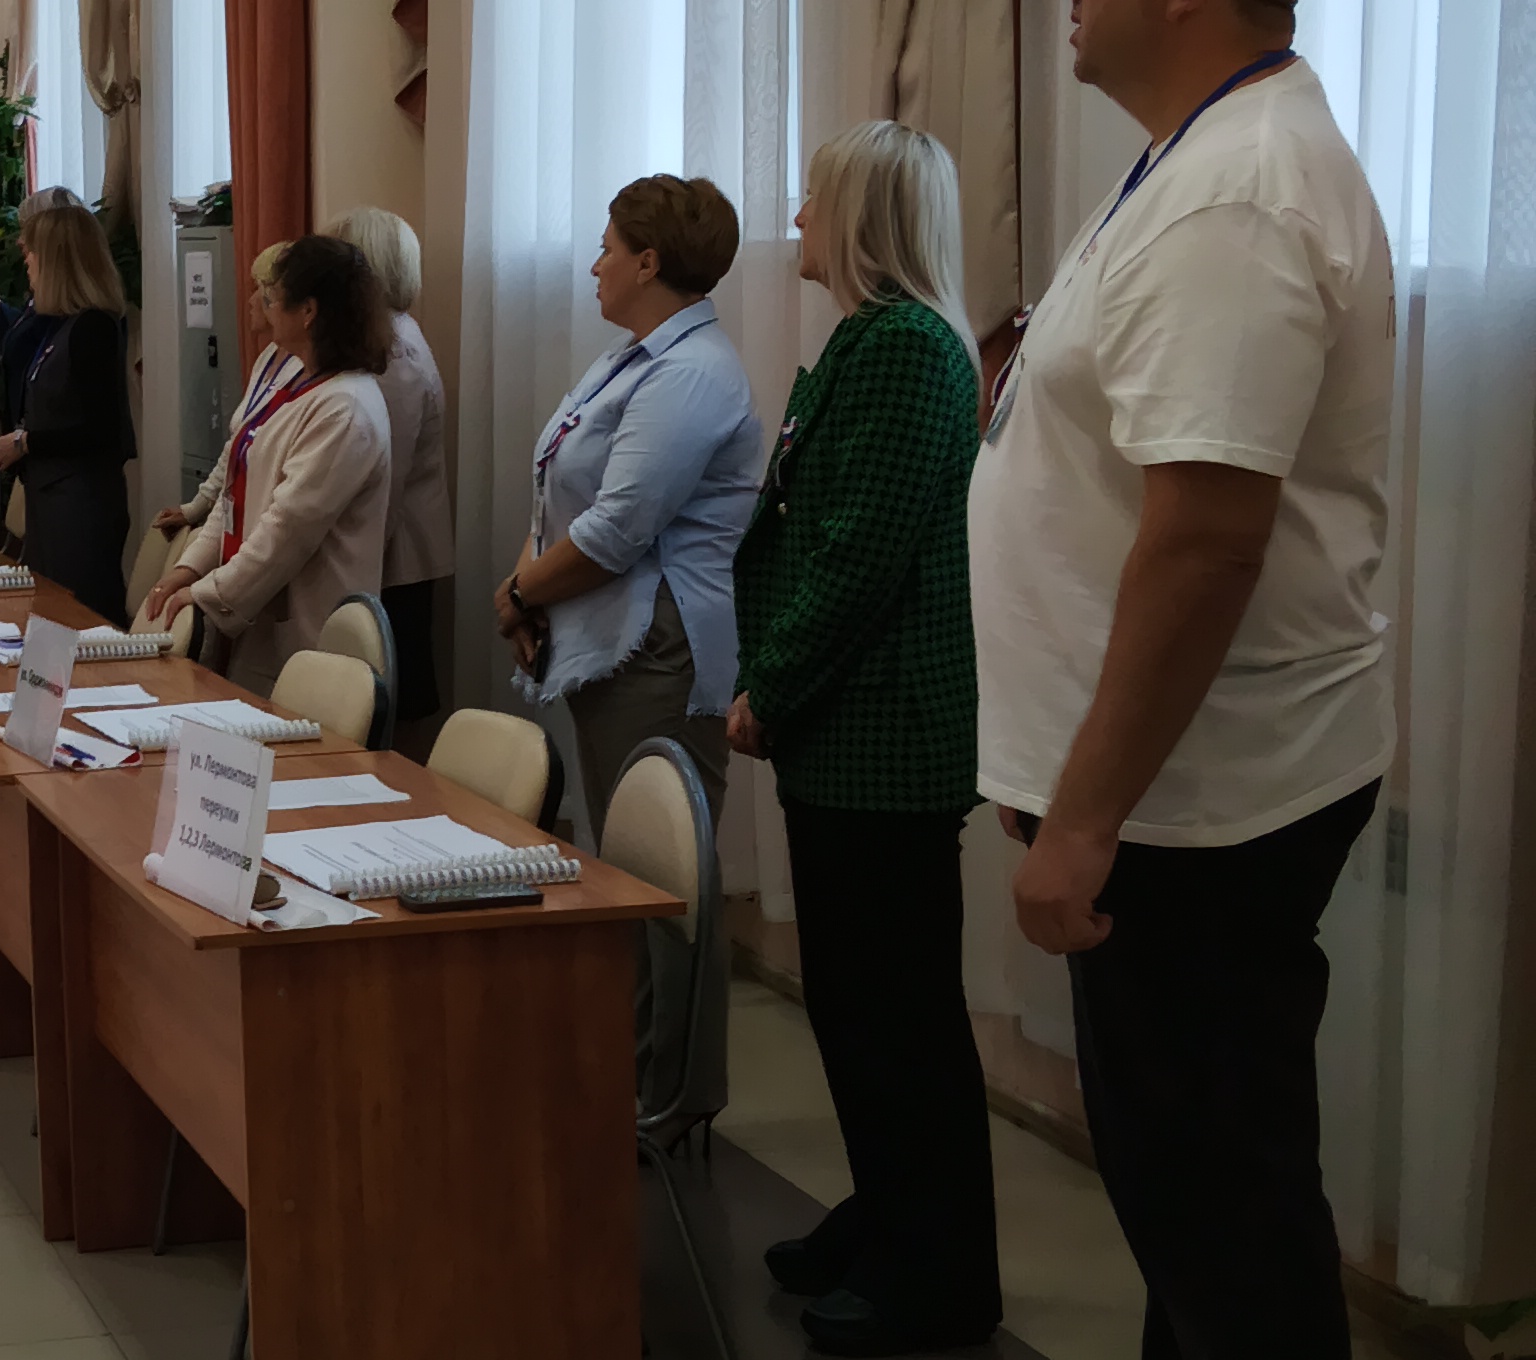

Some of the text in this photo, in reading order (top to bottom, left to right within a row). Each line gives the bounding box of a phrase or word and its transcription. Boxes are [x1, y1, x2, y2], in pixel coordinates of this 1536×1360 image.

[190, 752, 258, 789] ул. Лермонтова
[200, 796, 240, 824] переулки
[199, 833, 252, 872] Лермонтова
